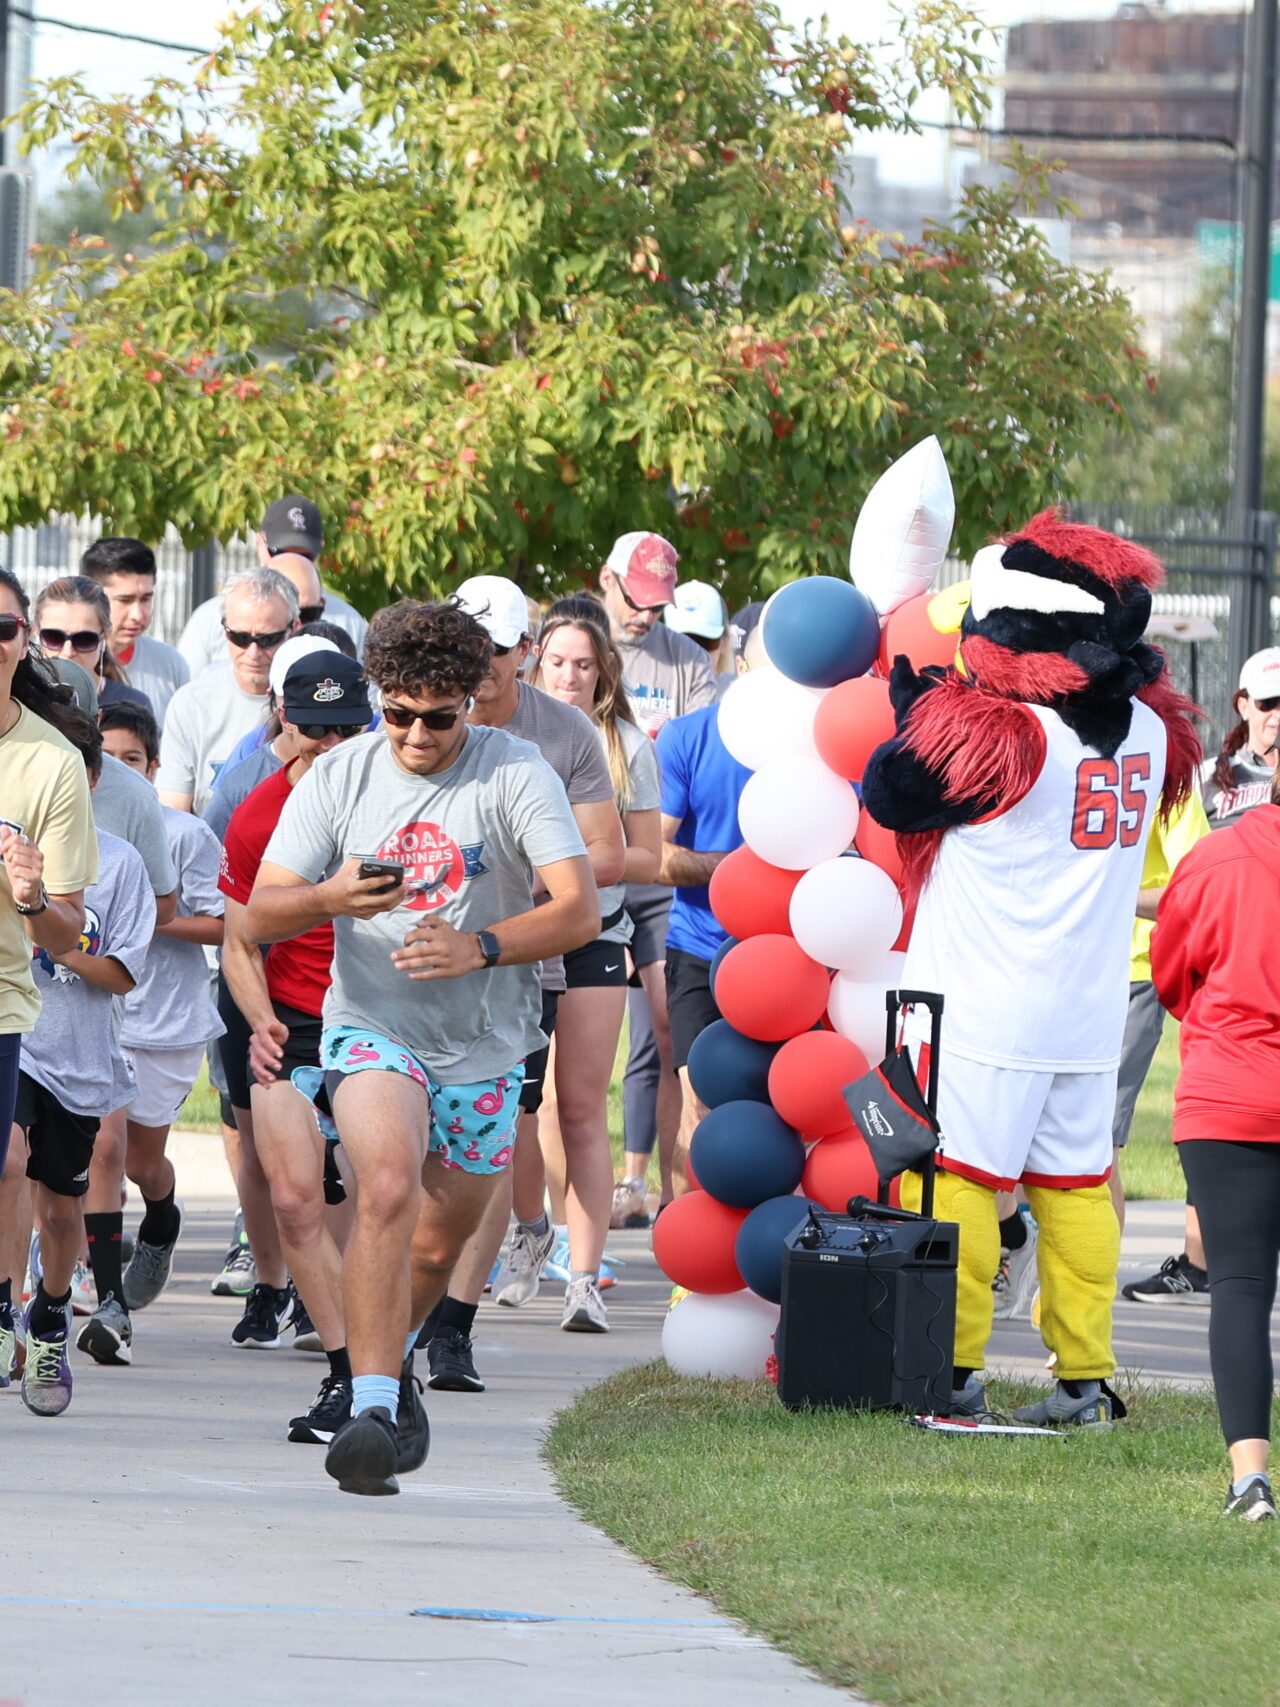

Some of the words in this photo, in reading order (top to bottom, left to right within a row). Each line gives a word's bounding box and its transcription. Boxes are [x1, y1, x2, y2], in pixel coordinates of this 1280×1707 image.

[1069, 751, 1151, 850] 65
[383, 829, 452, 854] ROAD
[819, 1254, 839, 1262] ION
